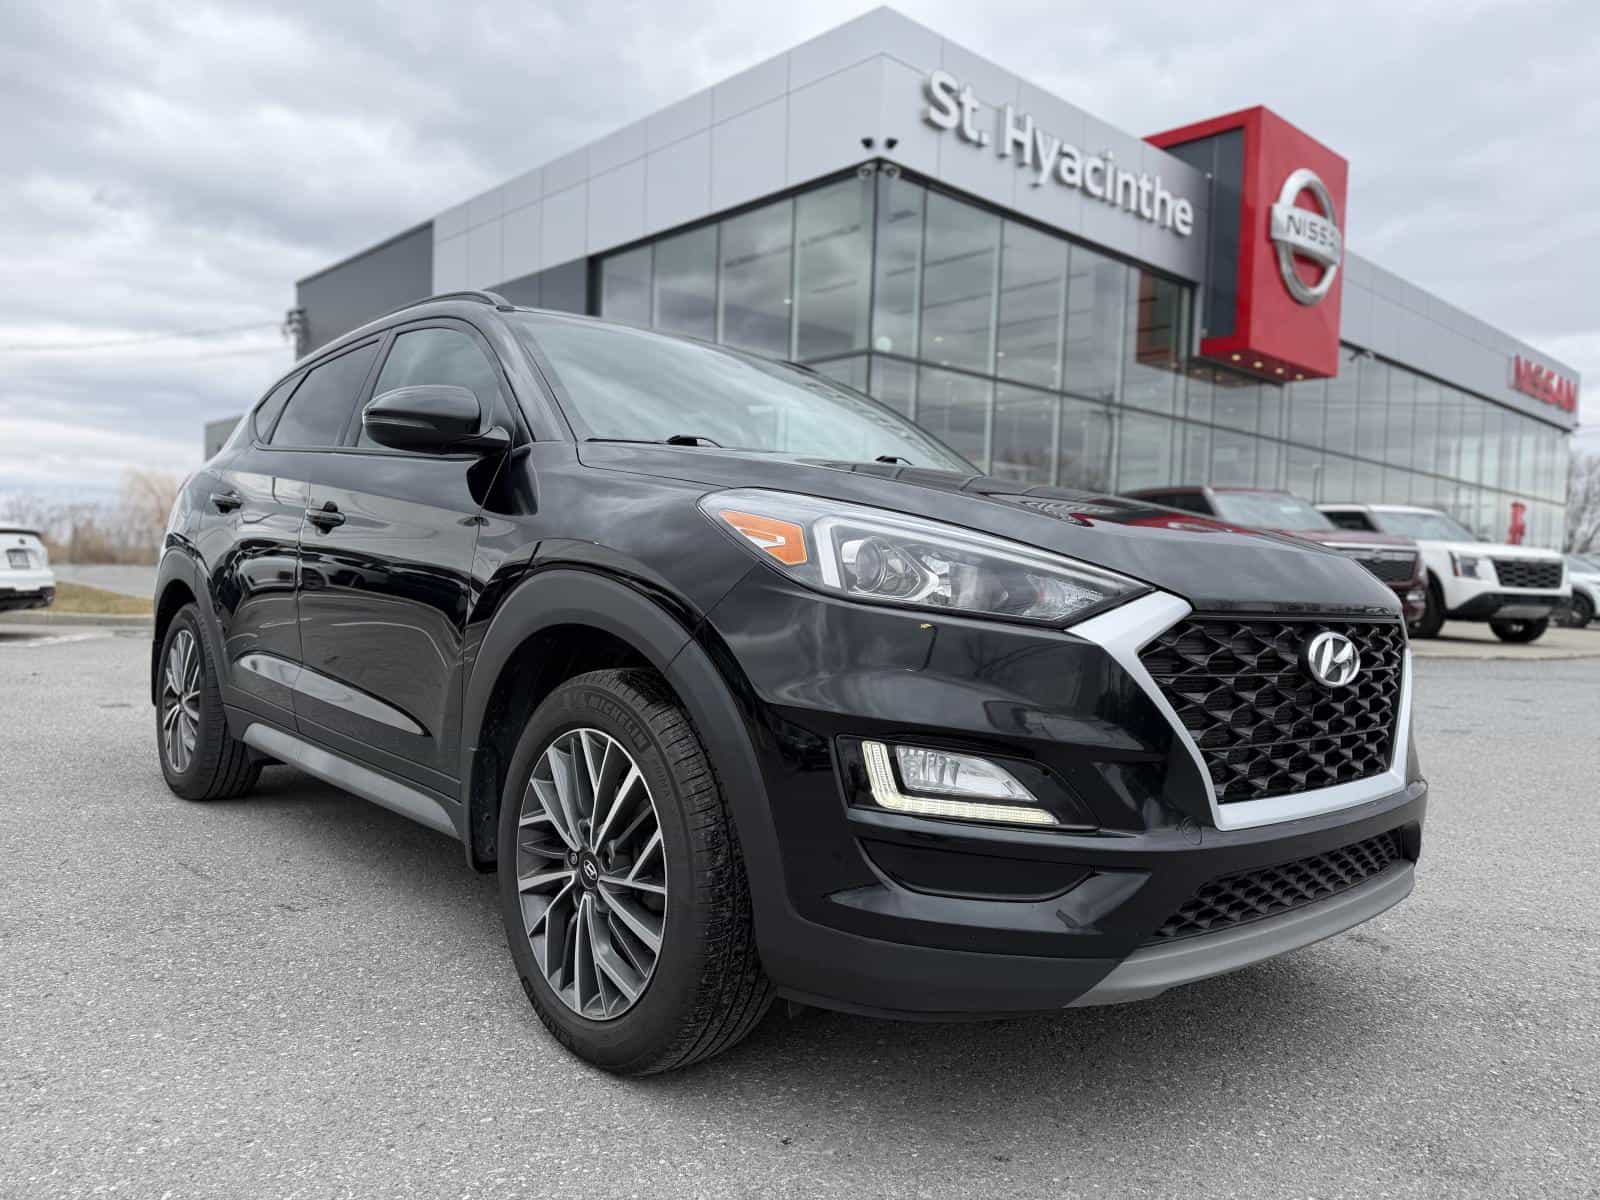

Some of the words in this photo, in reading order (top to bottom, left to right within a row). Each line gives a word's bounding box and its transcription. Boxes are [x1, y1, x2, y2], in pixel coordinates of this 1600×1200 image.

[926, 70, 989, 145] St.
[1003, 105, 1193, 236] Hyacinthe
[1286, 213, 1338, 250] NISS
